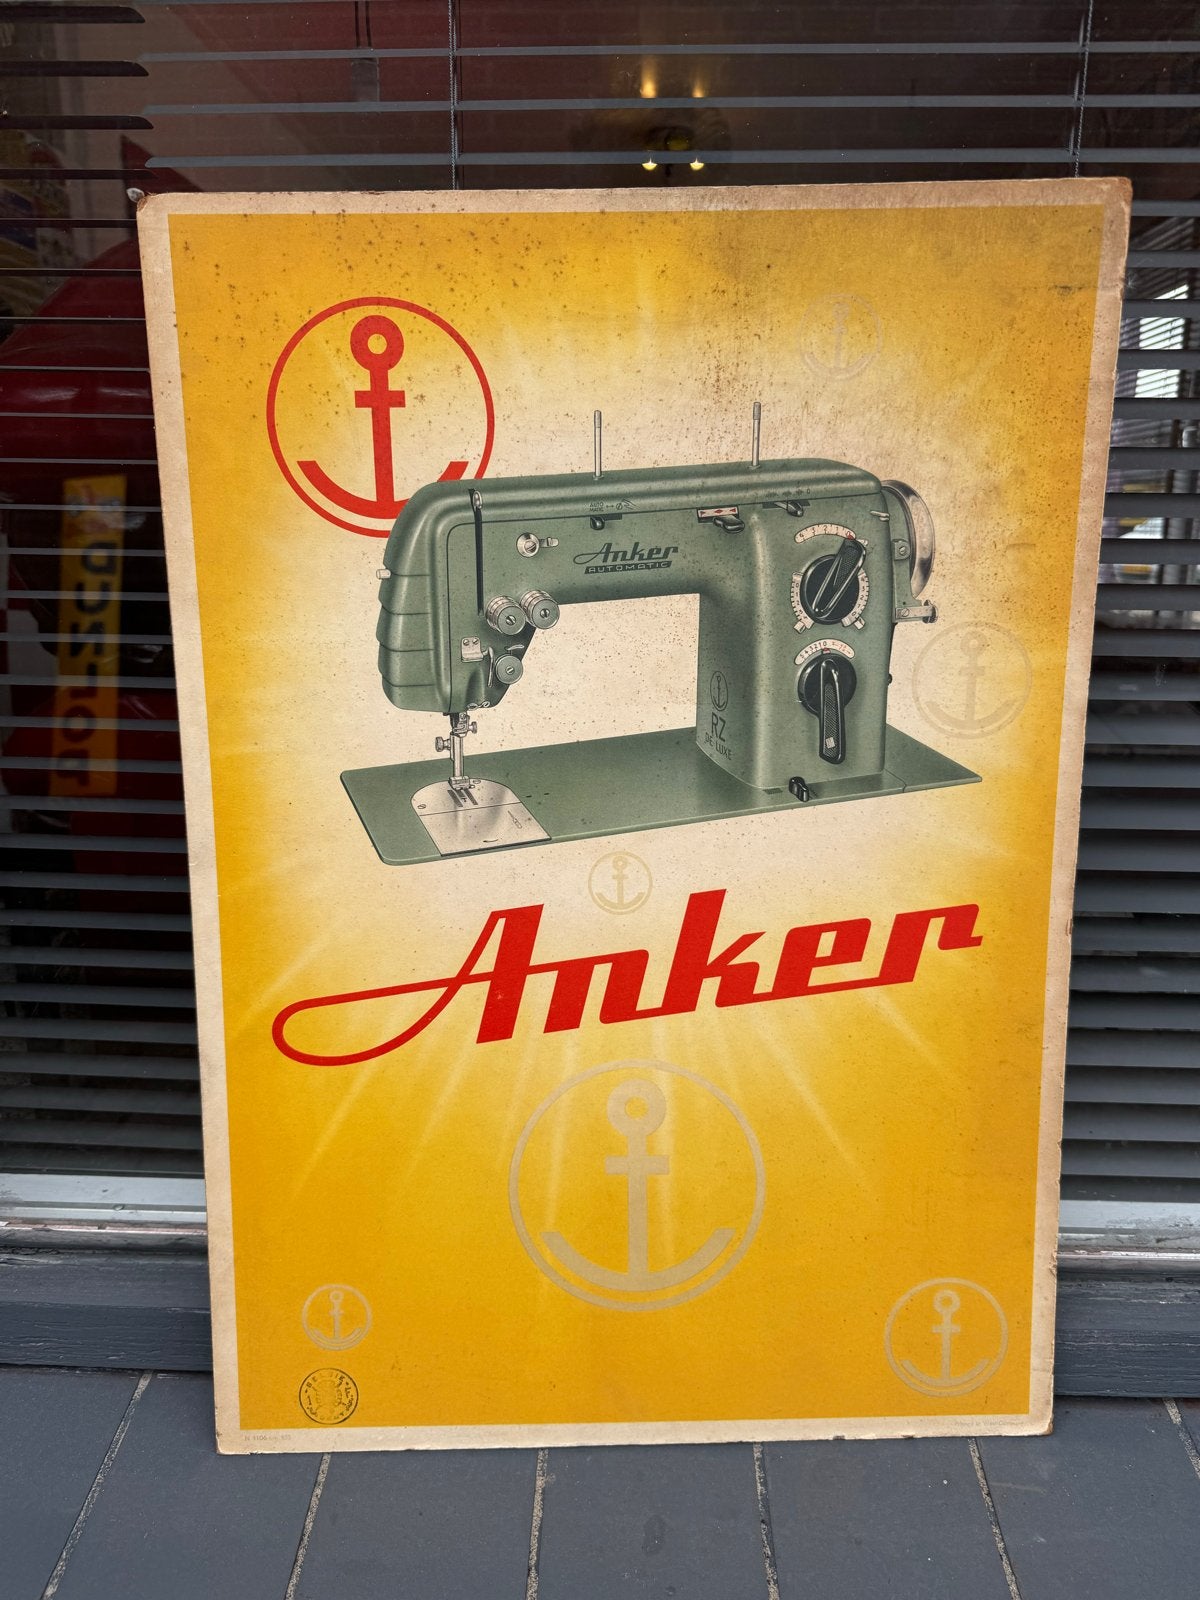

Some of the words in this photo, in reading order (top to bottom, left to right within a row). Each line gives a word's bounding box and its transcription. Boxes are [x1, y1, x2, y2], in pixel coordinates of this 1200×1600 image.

[573, 541, 679, 565] Anker
[587, 562, 669, 574] AUTOMATIC
[711, 711, 727, 743] RZ
[272, 888, 983, 1067] Anker
